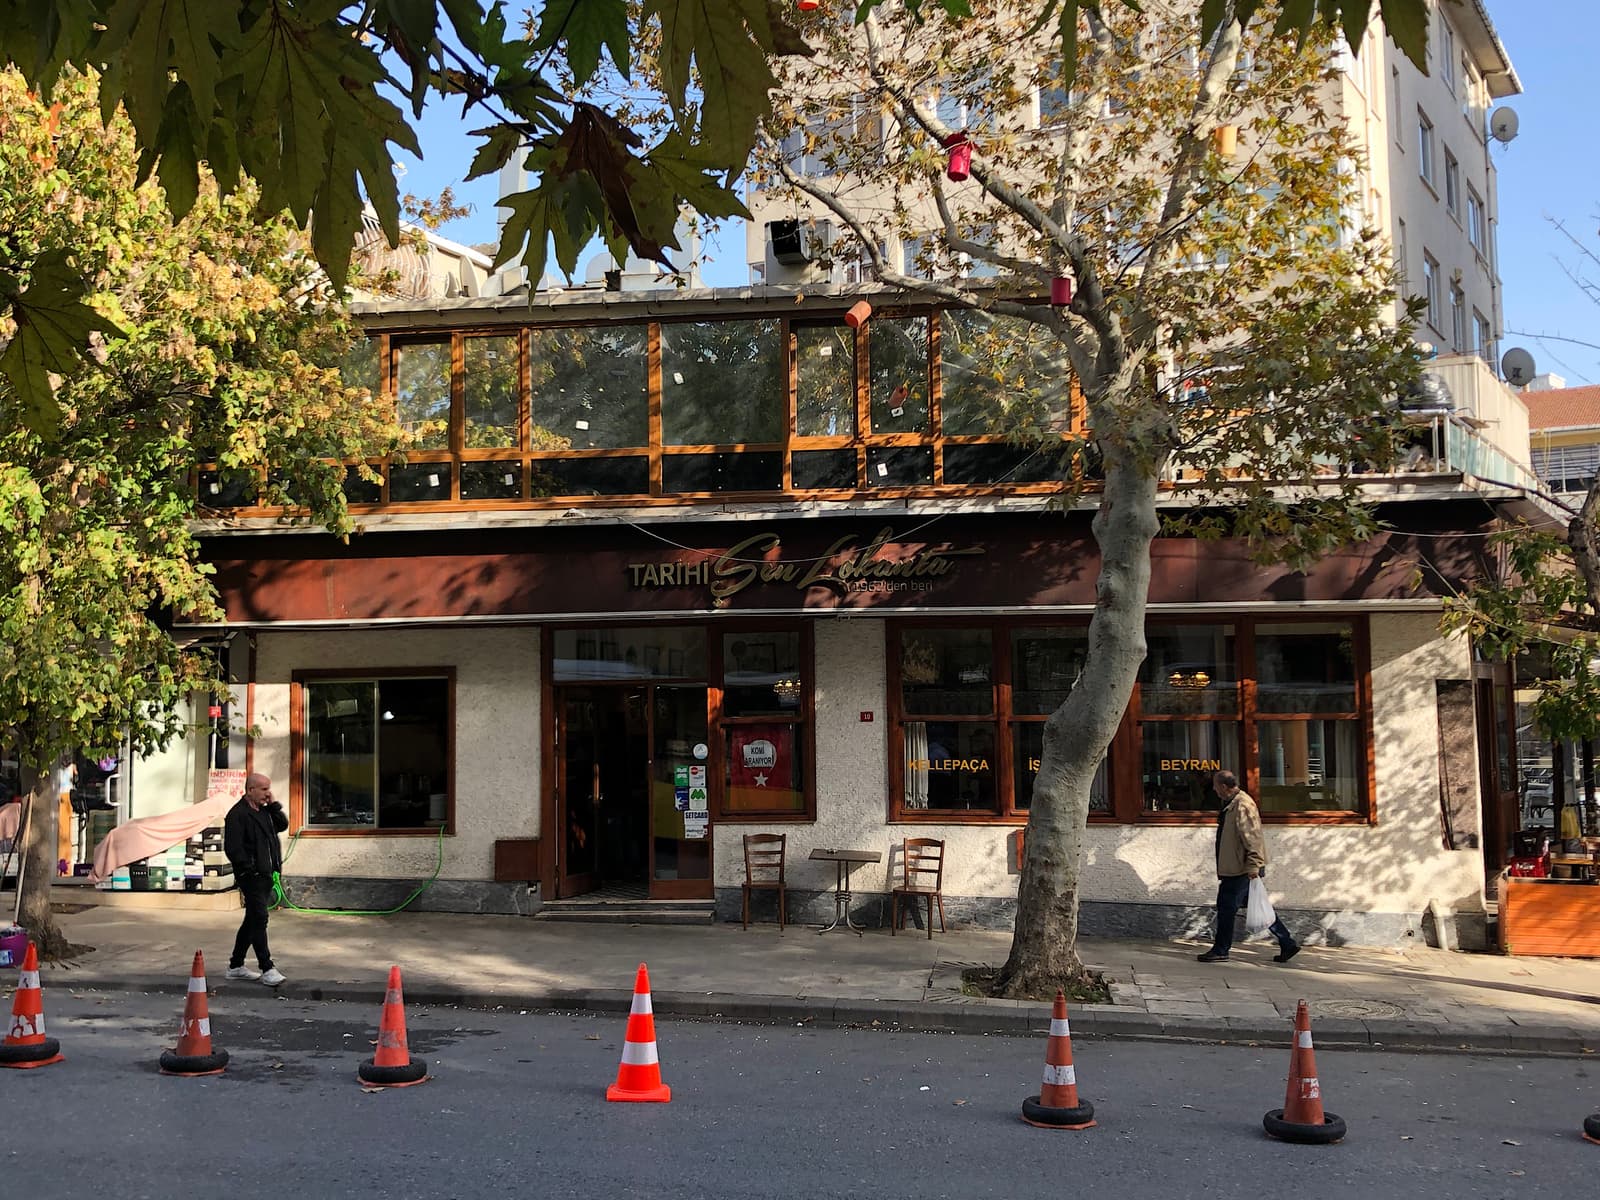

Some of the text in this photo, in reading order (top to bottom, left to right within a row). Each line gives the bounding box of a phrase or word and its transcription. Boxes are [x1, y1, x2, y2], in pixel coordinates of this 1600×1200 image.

[628, 557, 709, 586] TARİHİ
[796, 525, 986, 591] Lokanta
[911, 579, 934, 592] beri
[908, 759, 990, 773] KELLEPAÇA
[1161, 759, 1220, 771] BEYRAN
